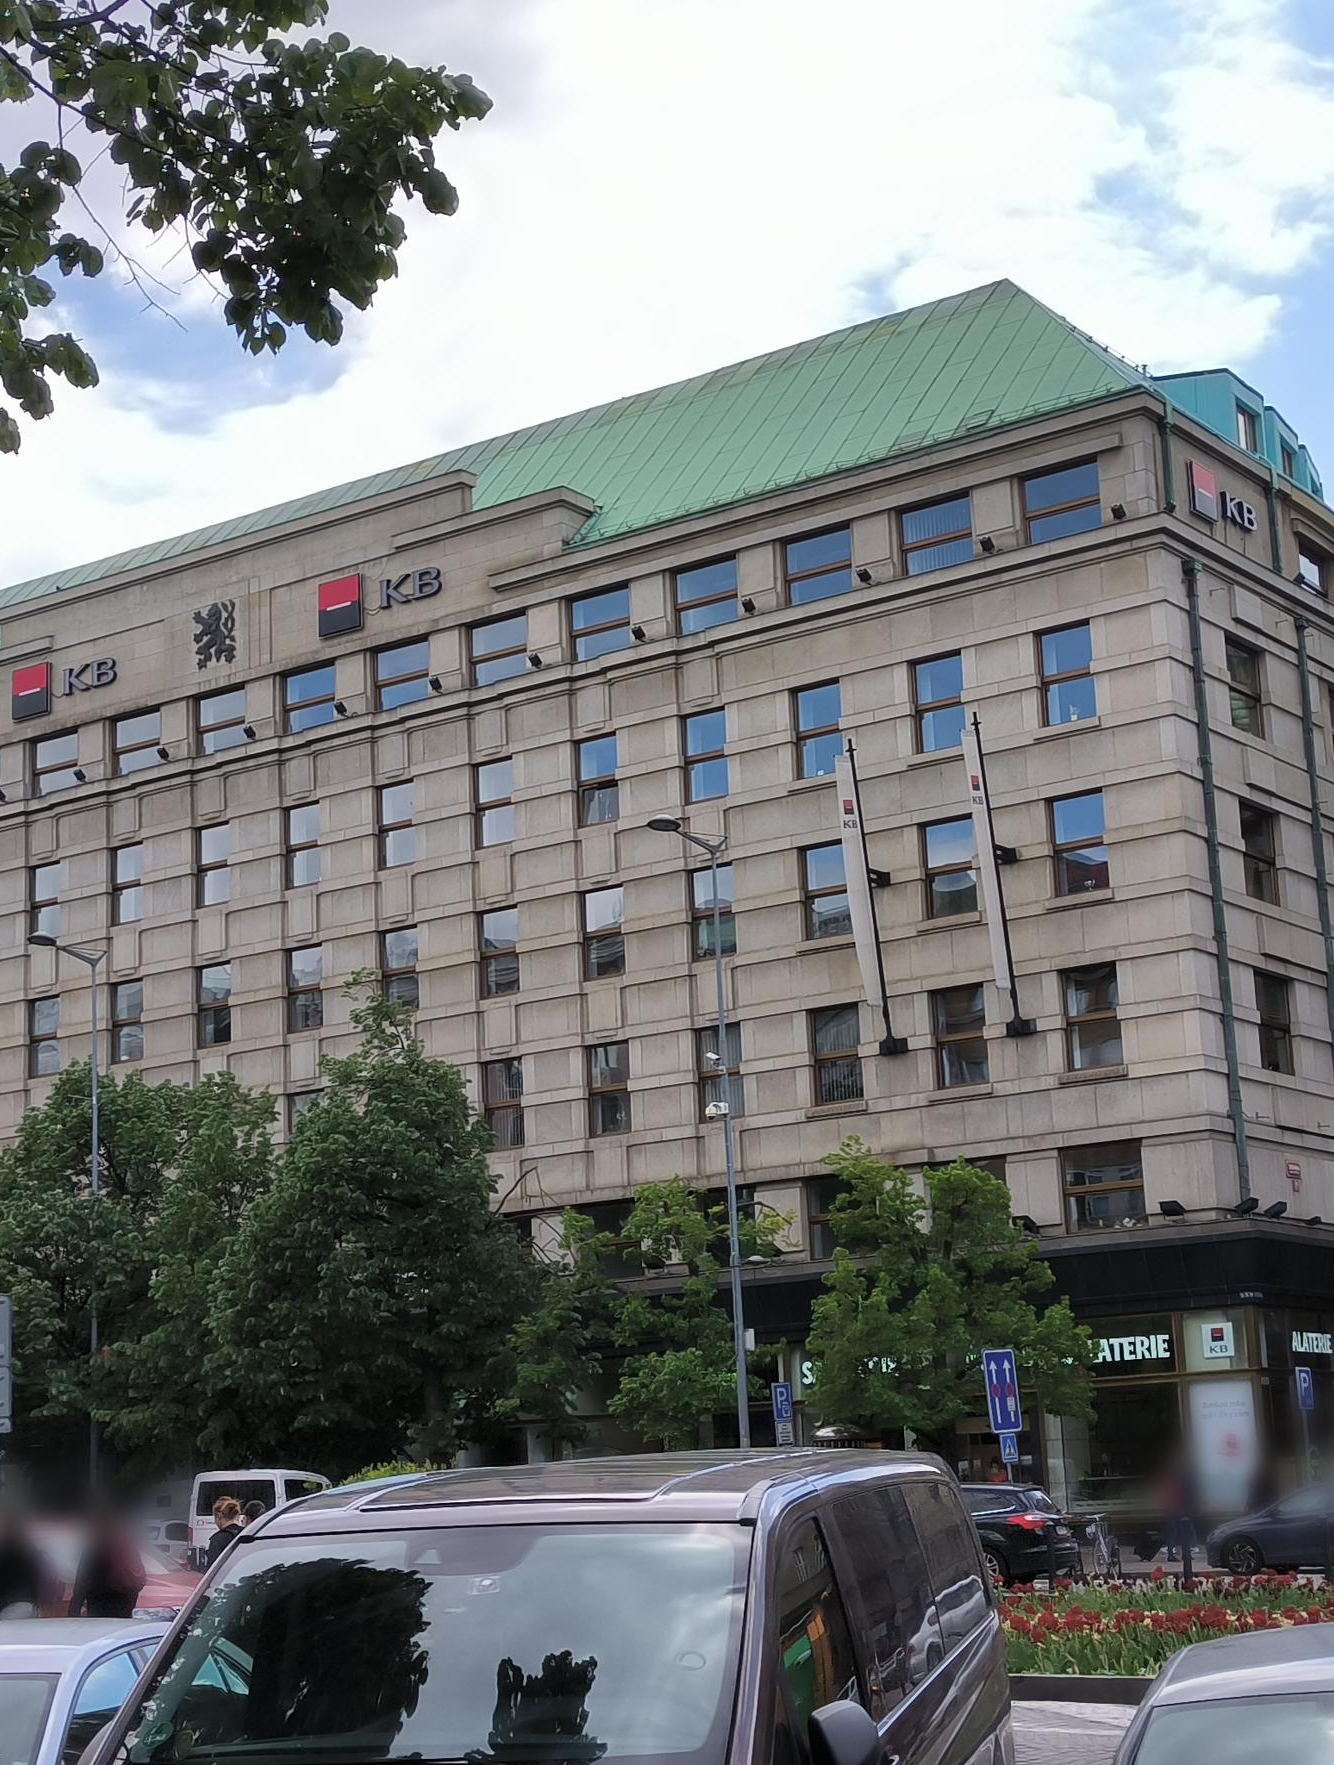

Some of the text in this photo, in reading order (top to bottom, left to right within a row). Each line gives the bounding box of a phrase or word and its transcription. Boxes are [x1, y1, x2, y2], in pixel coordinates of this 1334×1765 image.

[1219, 490, 1259, 532] KB
[378, 566, 442, 610] KB
[62, 657, 117, 695] KB
[972, 796, 983, 805] KB
[843, 820, 858, 829] KB
[1209, 1344, 1228, 1354] KB
[1292, 1331, 1333, 1353] ALATERIE
[1301, 1373, 1310, 1393] P
[777, 1387, 787, 1408] P
